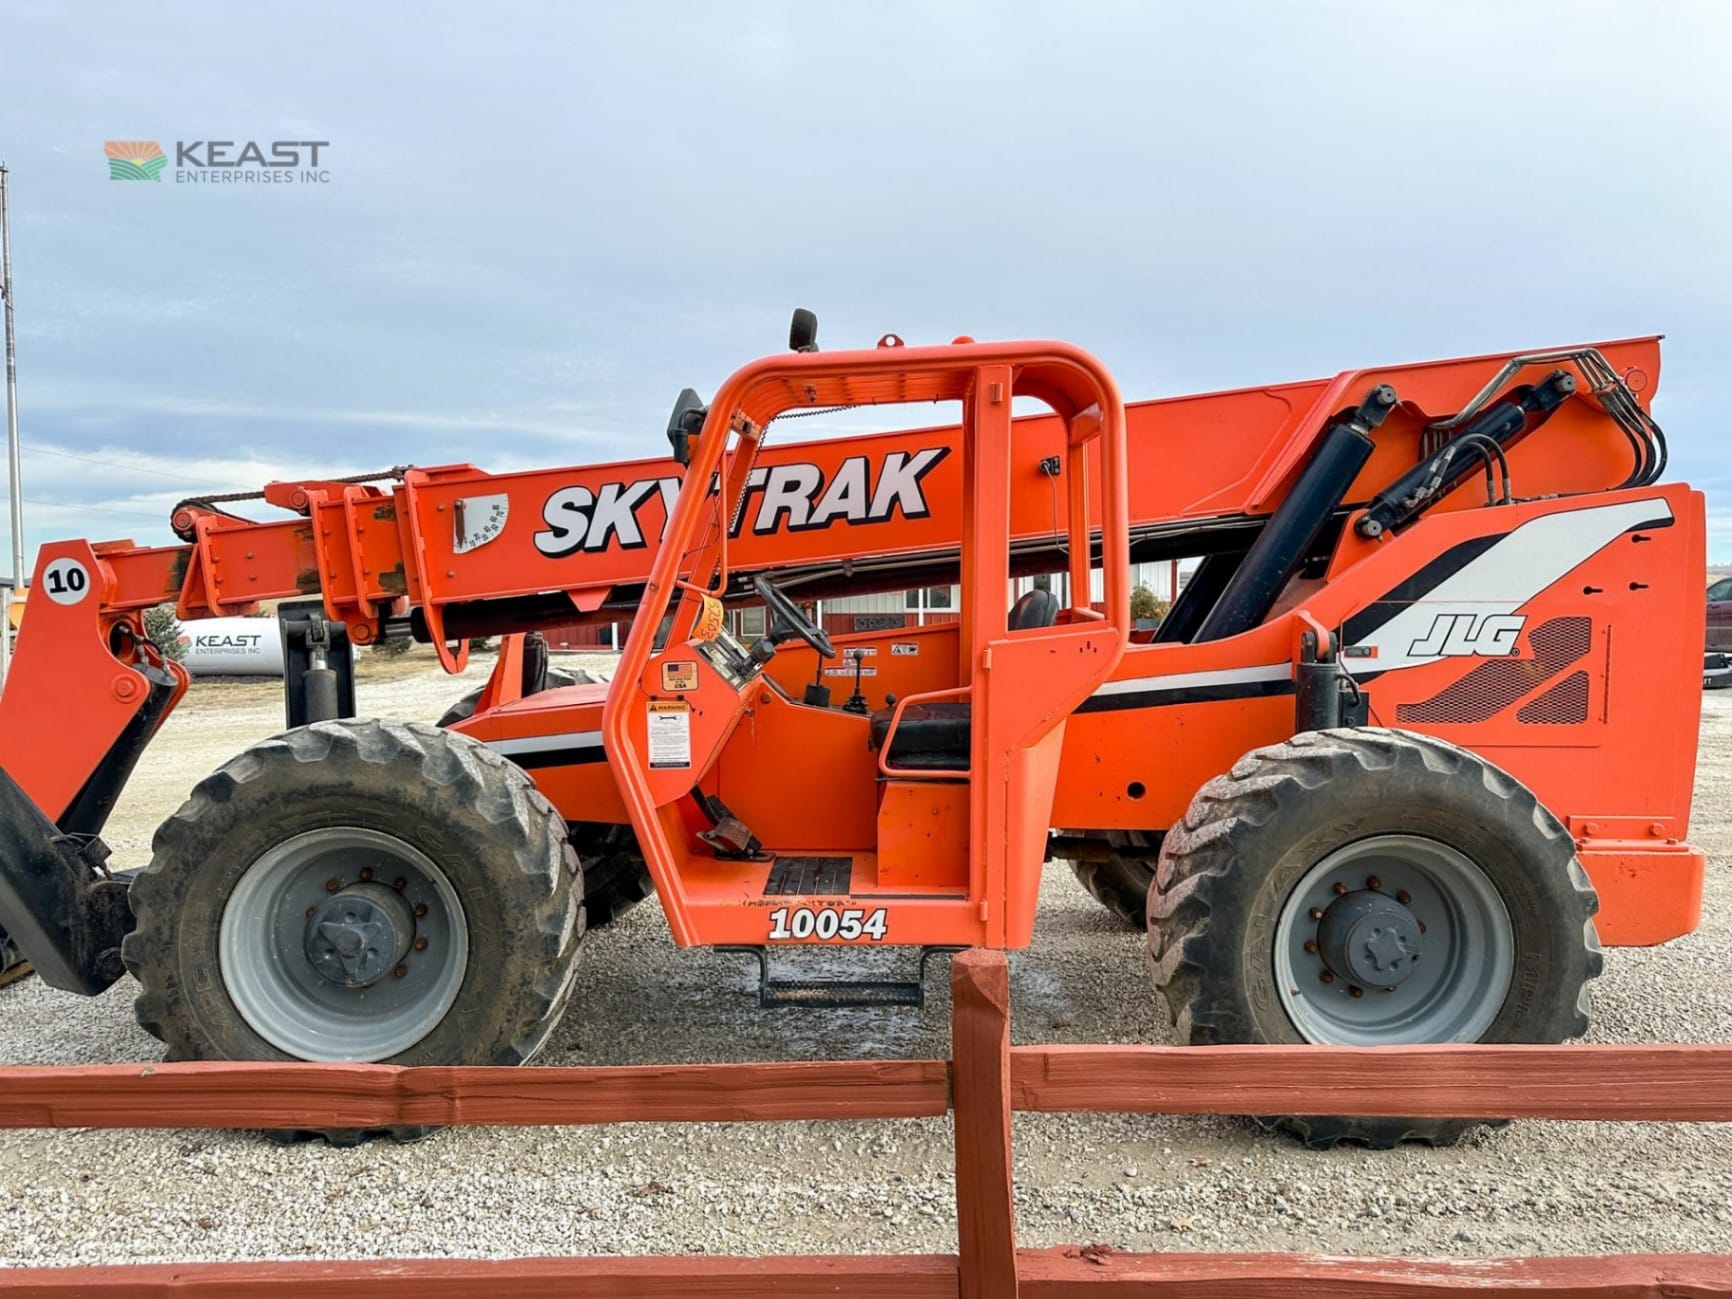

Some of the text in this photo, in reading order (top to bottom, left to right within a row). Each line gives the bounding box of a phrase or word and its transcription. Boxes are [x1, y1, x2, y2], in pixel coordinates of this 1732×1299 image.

[48, 567, 85, 594] 10
[196, 635, 262, 647] KEAST
[1407, 613, 1528, 657] JLG
[195, 647, 261, 655] ENTERPRISES INC
[768, 907, 888, 941] 10054
